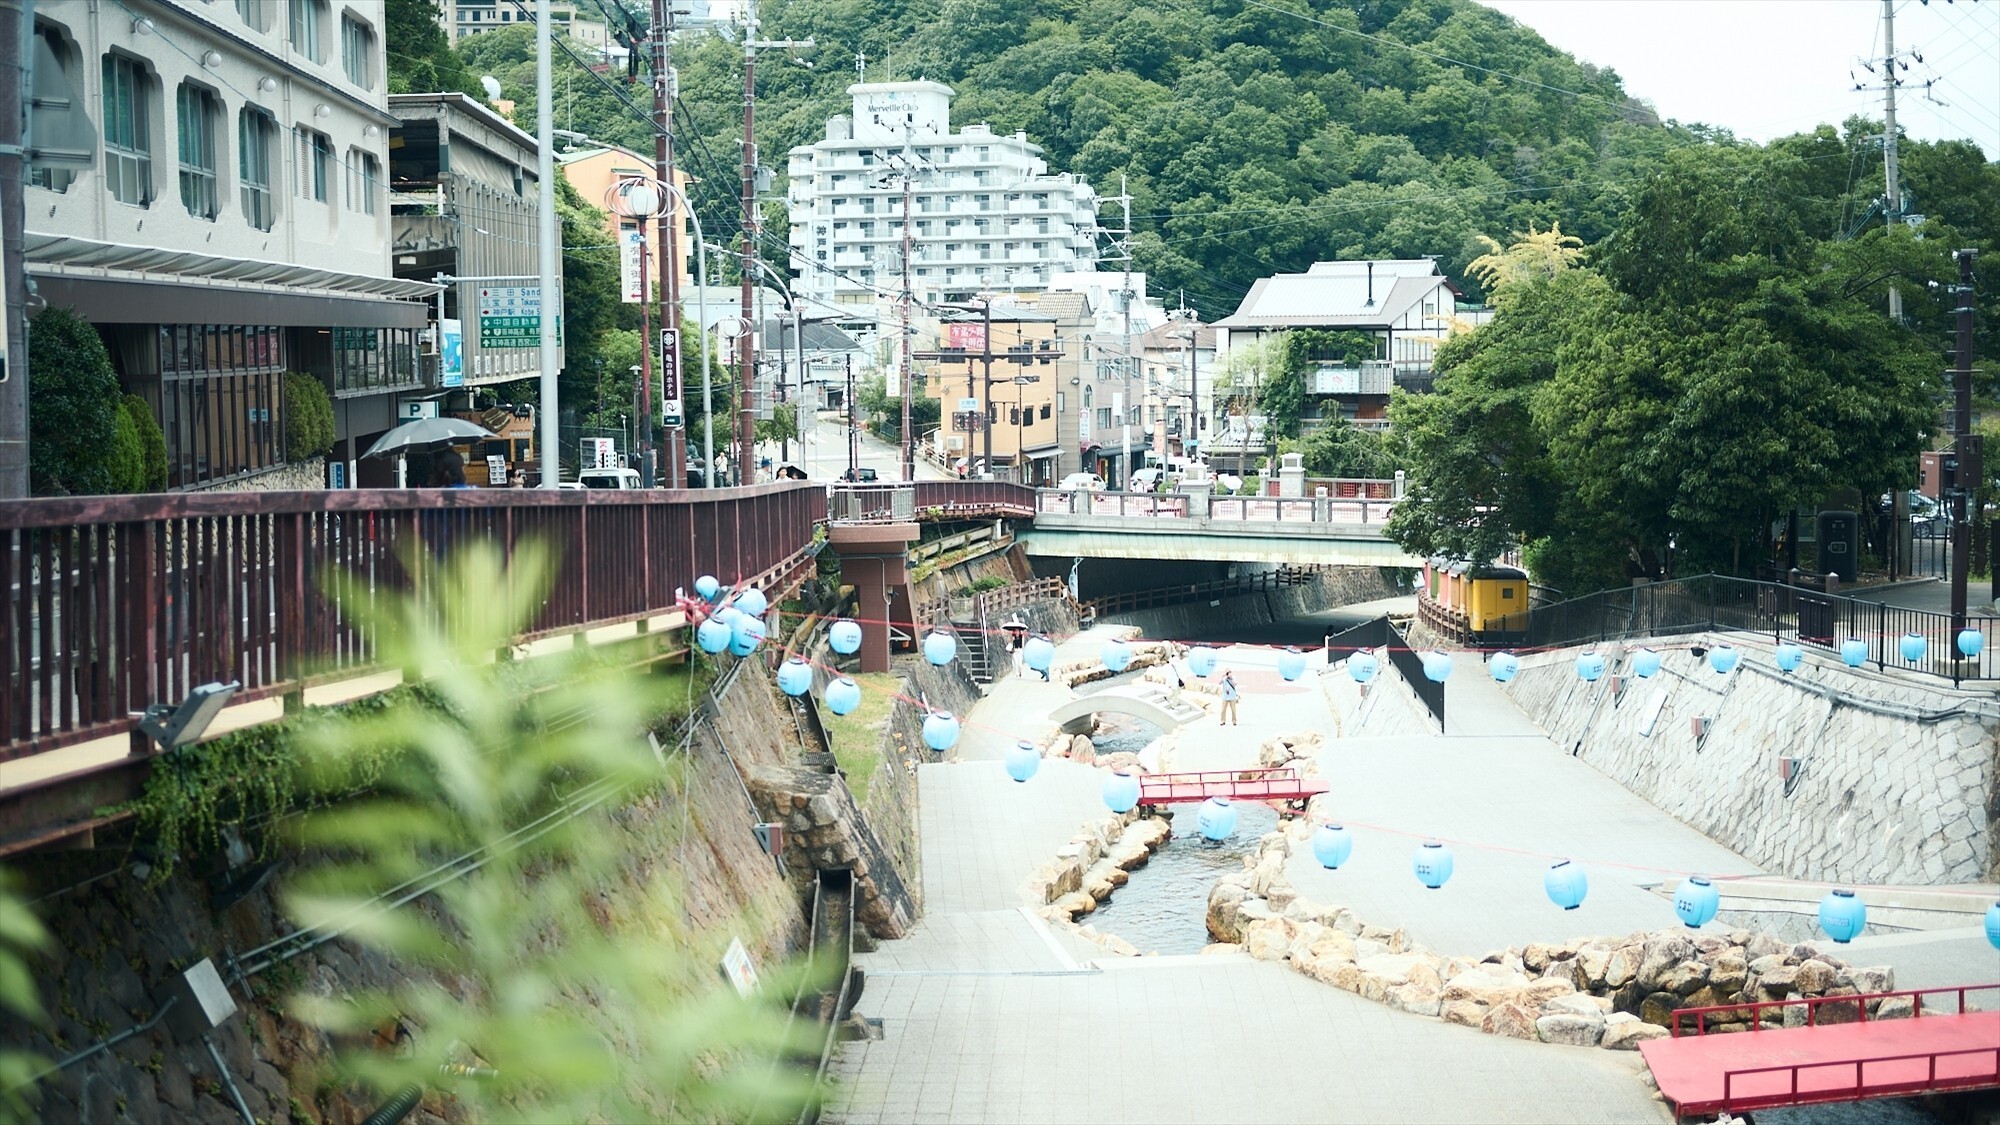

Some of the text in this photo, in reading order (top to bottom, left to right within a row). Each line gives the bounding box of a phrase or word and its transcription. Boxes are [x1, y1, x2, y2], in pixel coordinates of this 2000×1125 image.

[521, 288, 540, 296] Sand
[494, 318, 538, 327] 中国自動車
[665, 353, 674, 397] 亀の井ホテル
[409, 403, 421, 416] P
